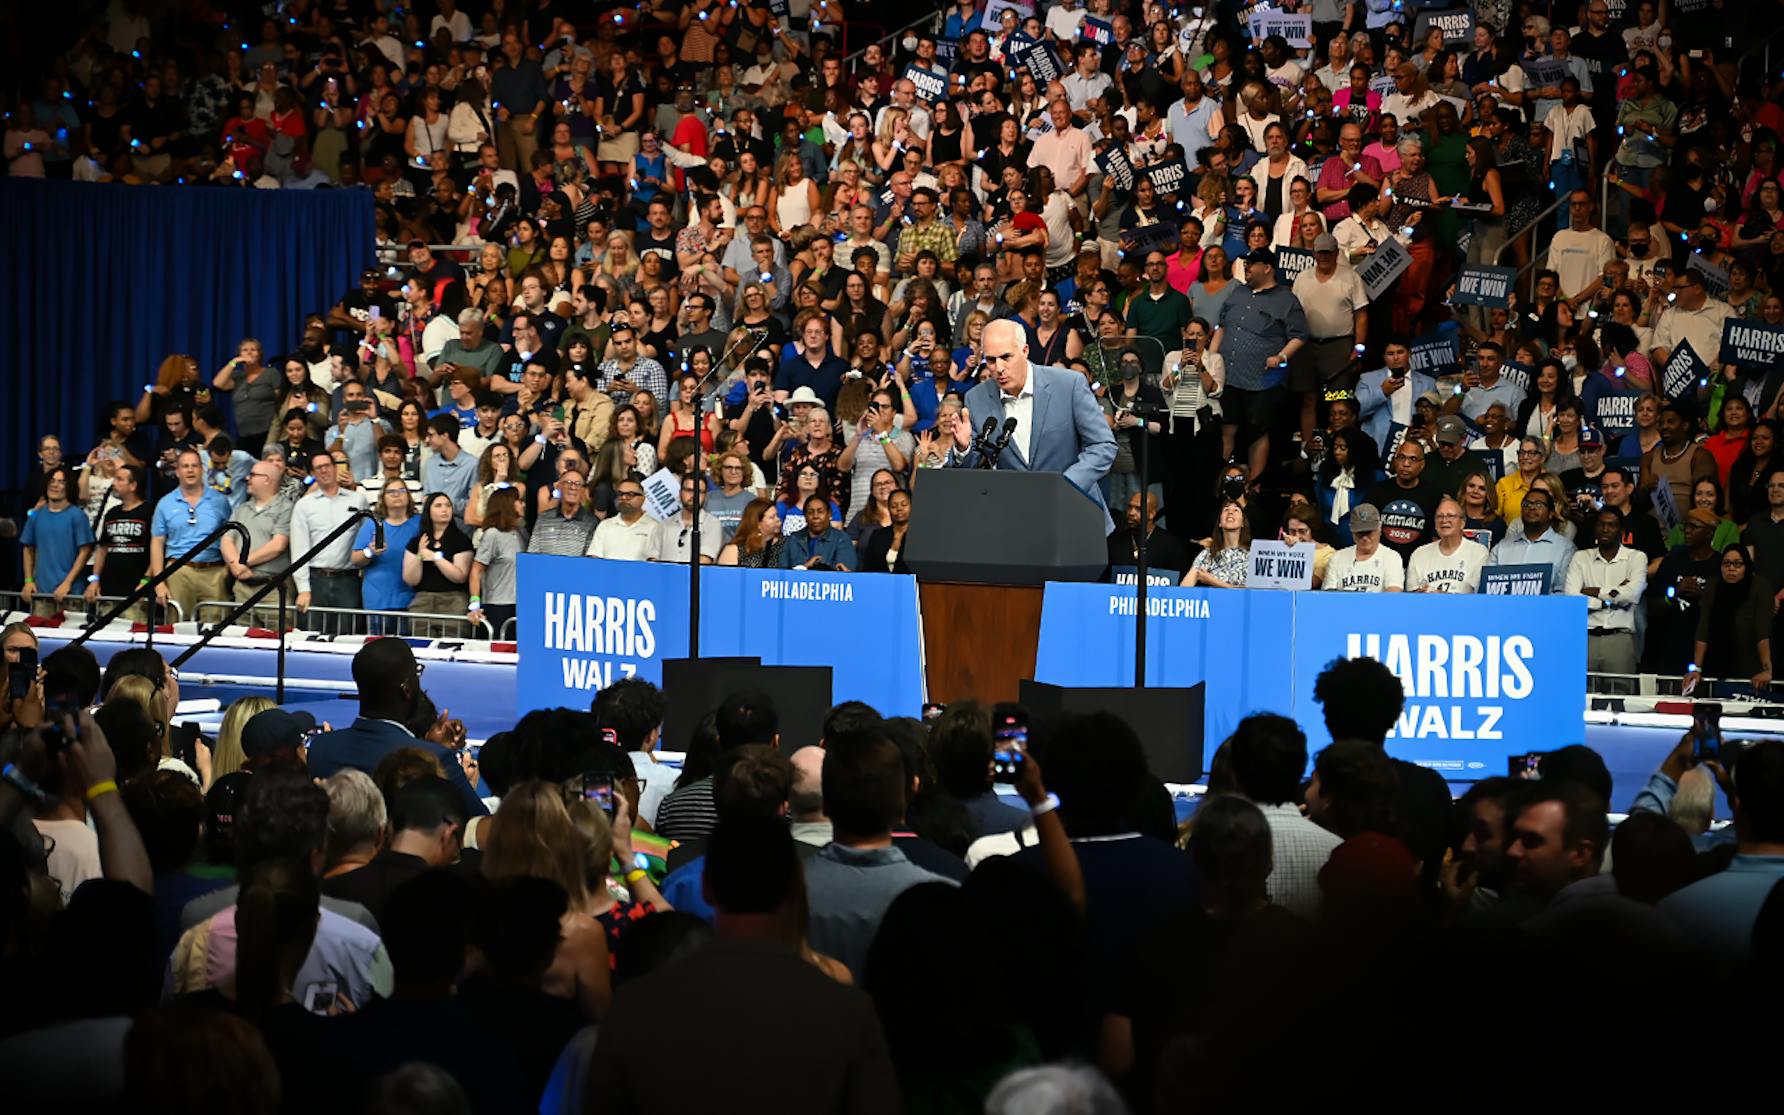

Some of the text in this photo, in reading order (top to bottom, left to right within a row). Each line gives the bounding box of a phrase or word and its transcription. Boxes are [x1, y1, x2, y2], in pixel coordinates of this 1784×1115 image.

[1284, 26, 1306, 39] WIN
[1443, 28, 1465, 39] ALZ
[1030, 45, 1057, 81] HARRIS
[906, 69, 944, 95] HARRIS
[1107, 148, 1134, 191] HARRIS
[1149, 164, 1183, 186] ARRIS
[1361, 247, 1400, 286] WE WIN
[1460, 277, 1507, 298] WE WIN
[1729, 326, 1784, 353] HARRIS
[1429, 347, 1456, 368] WIN
[1737, 348, 1776, 364] WALZ
[1669, 369, 1696, 398] WALZ
[1597, 396, 1637, 416] HARRI
[1602, 416, 1634, 428] WALZ
[648, 479, 675, 510] WIN
[107, 522, 142, 536] HARRIS
[1389, 529, 1412, 539] 2024
[1255, 557, 1306, 579] WE WIN
[1428, 569, 1465, 583] HARRIS
[1523, 571, 1543, 579] FIGHT
[762, 580, 854, 602] PHILADELPHIA
[1342, 574, 1381, 588] HARRIS
[1486, 580, 1543, 595] WE WIN
[544, 592, 657, 659] HARRIS
